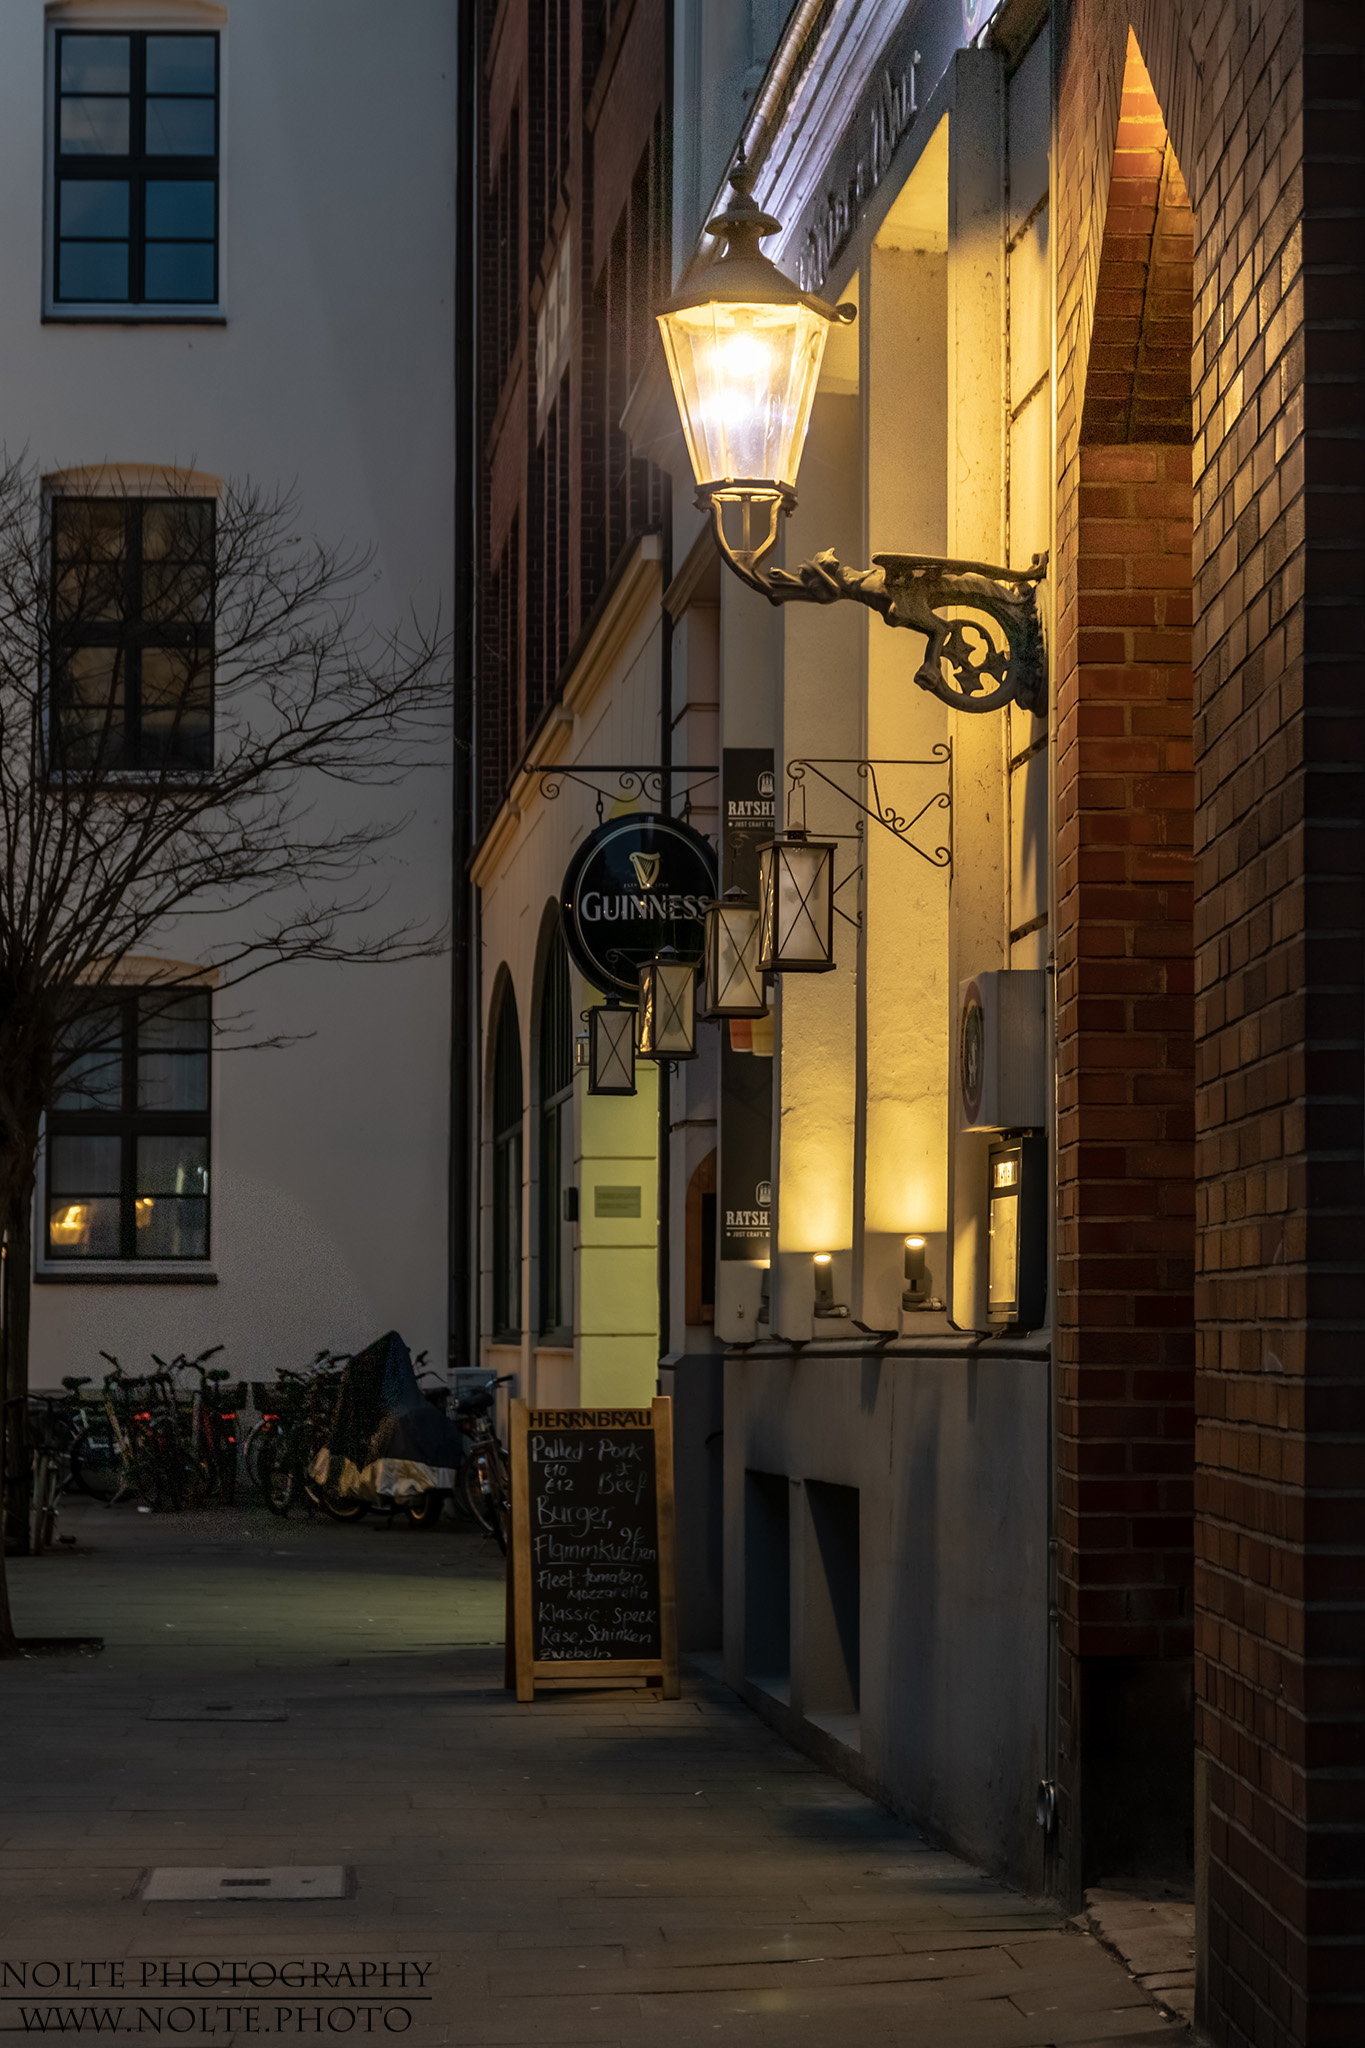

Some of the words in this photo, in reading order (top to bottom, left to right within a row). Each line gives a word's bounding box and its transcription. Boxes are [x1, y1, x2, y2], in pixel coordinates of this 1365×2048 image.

[529, 1410, 651, 1428] HERRNBRÄU
[598, 1438, 644, 1462] Pork
[598, 1470, 648, 1506] Beef
